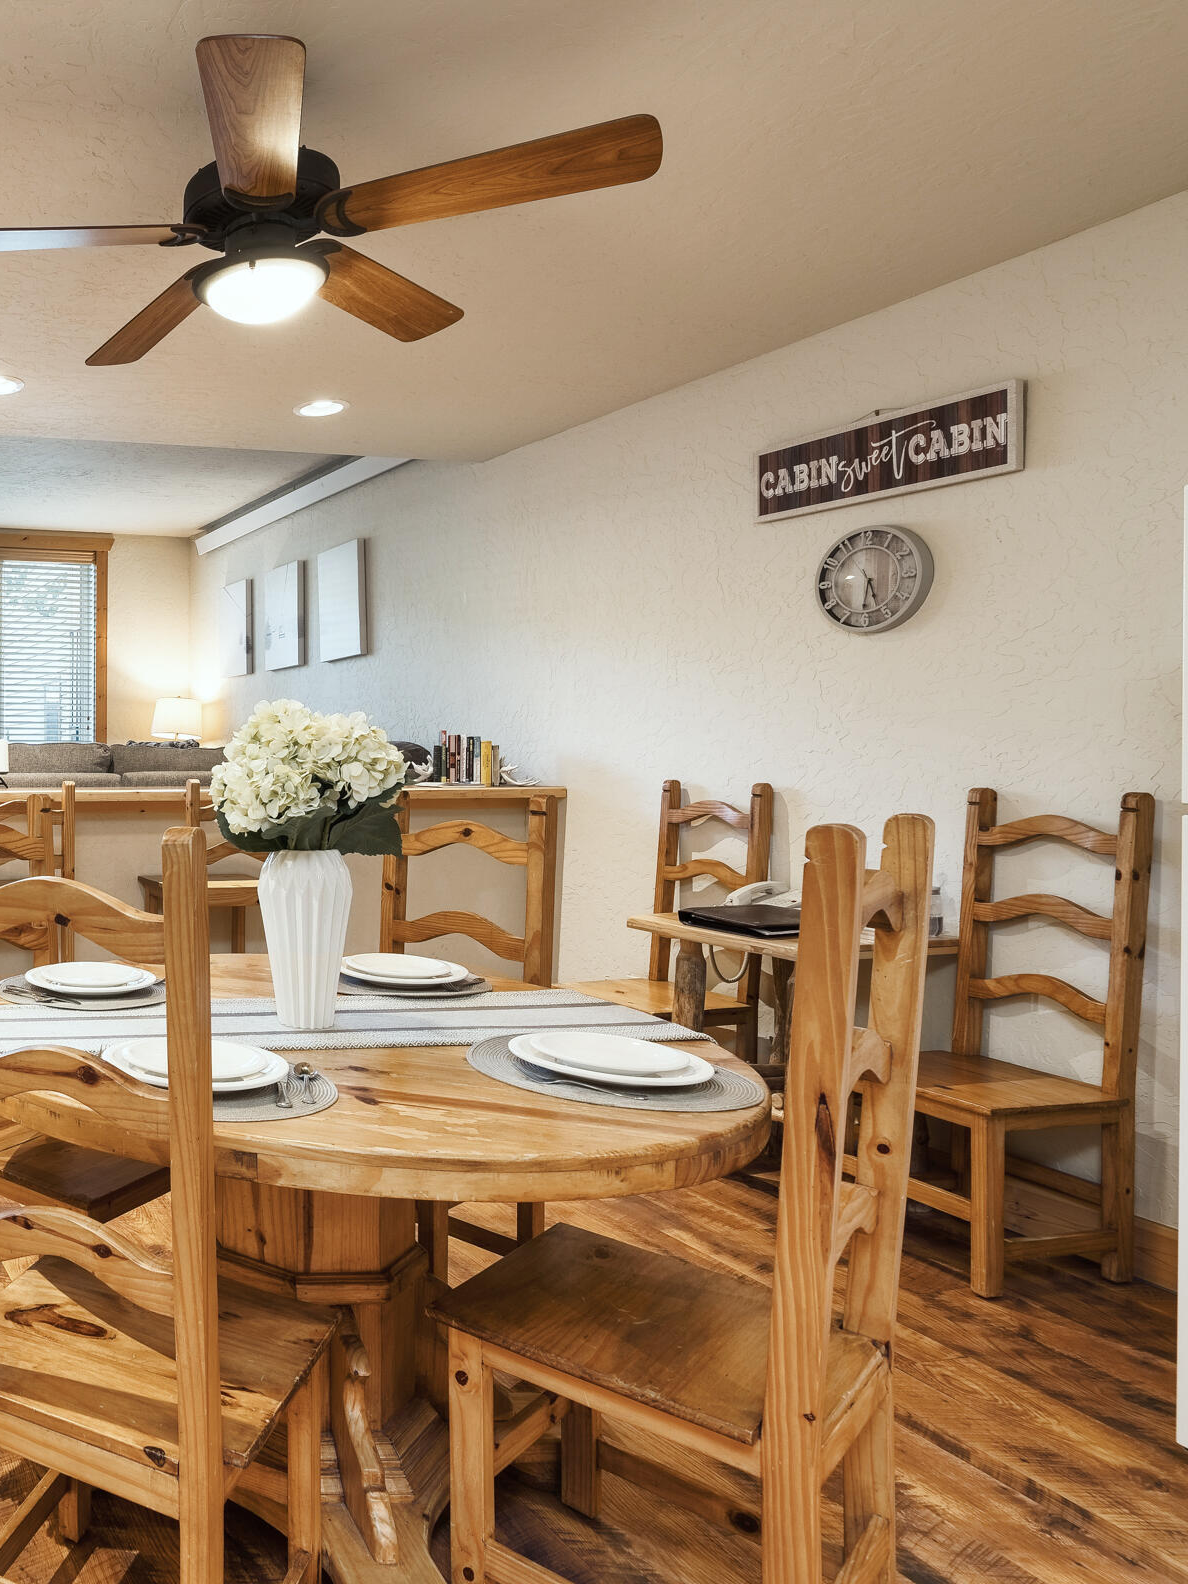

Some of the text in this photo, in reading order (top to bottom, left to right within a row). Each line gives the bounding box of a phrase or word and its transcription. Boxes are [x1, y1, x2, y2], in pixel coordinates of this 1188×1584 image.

[760, 413, 1008, 499] CABIN sweet CABIN
[859, 531, 873, 545] 12
[884, 534, 893, 548] 1
[839, 539, 853, 554] 11
[895, 544, 910, 560] 2
[824, 558, 838, 570] 10
[902, 569, 917, 577] 3
[818, 581, 832, 590] 9
[896, 591, 910, 600] 4
[824, 599, 837, 610] 8
[839, 610, 851, 623] 7
[880, 605, 892, 618] 5
[861, 613, 869, 626] 6
